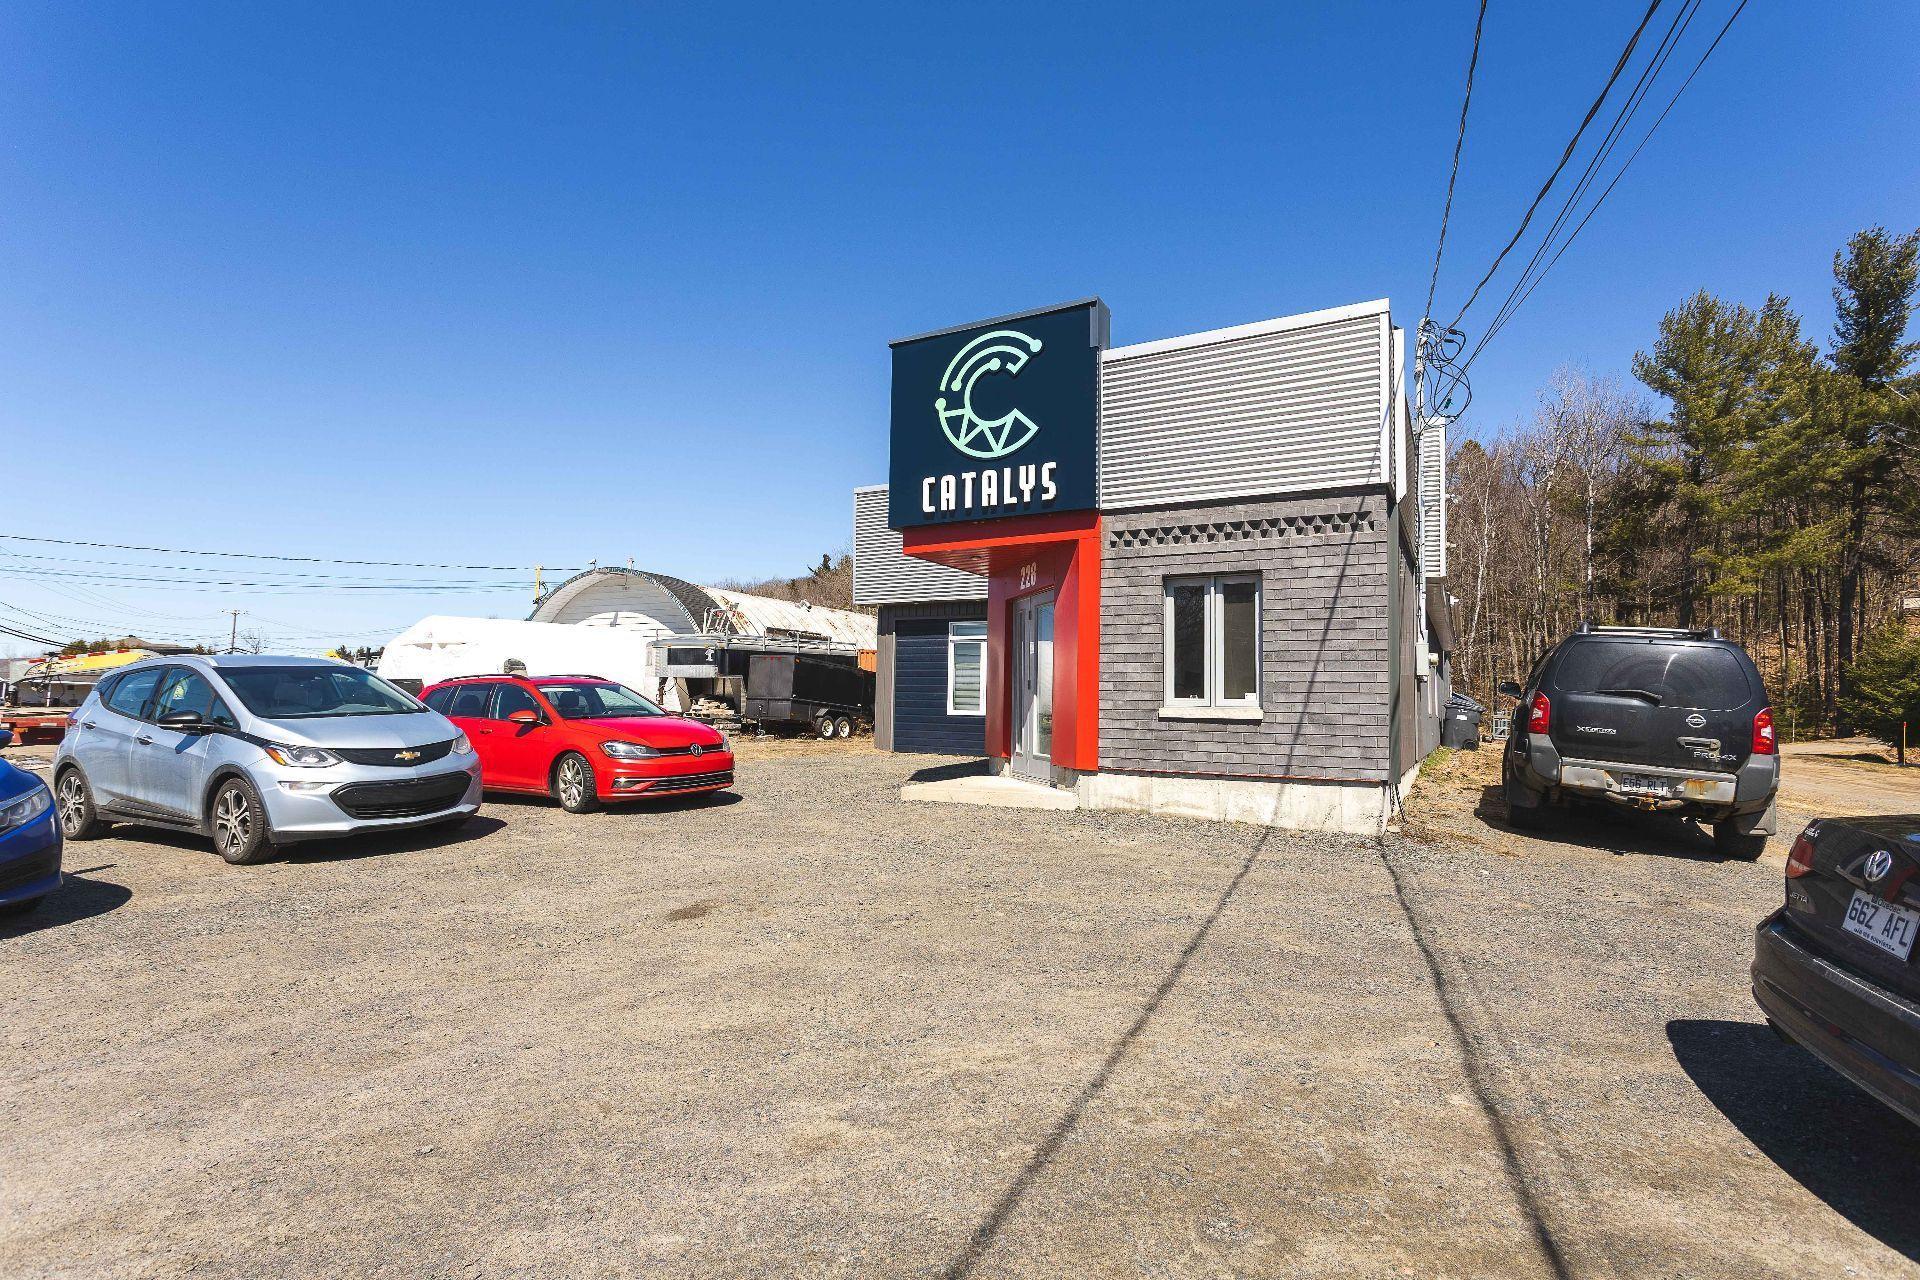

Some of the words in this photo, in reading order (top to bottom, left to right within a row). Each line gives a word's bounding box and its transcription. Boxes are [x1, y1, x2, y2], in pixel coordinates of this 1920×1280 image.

[922, 461, 1057, 513] CATALYS
[1020, 562, 1037, 590] 228
[1646, 780, 1667, 791] RLT
[1848, 897, 1880, 930] 66Z
[1881, 912, 1910, 948] AFL
